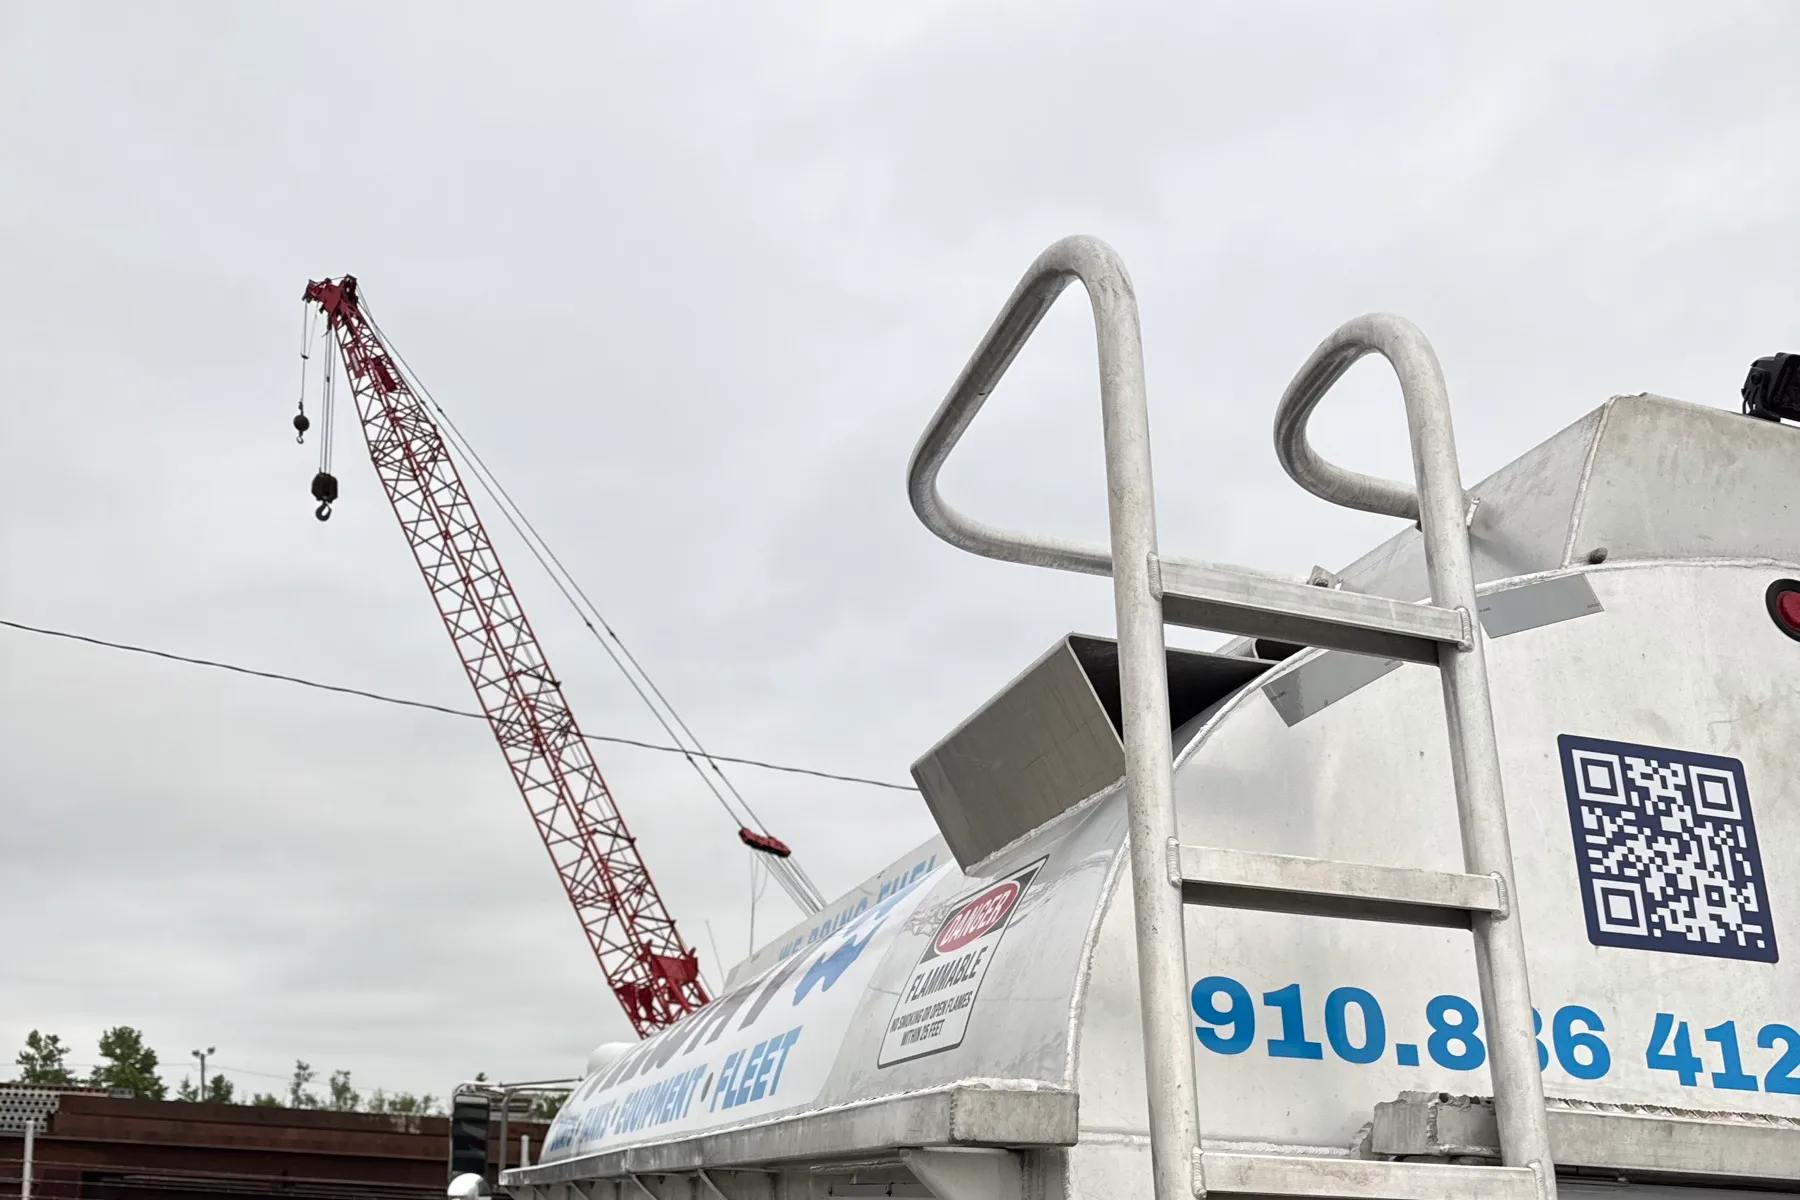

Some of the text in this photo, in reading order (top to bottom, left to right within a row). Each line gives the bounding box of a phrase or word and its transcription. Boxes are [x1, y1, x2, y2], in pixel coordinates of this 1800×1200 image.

[939, 889, 1012, 947] DANGER
[905, 946, 989, 1004] FLAMMABLE
[889, 990, 973, 1033] NO SMOKING OR OPEN FLAMES
[928, 1018, 945, 1039] FEET
[1190, 976, 1611, 1079] 910.86
[613, 1063, 708, 1135] EQUIPMENT
[709, 1025, 804, 1113] FLEET
